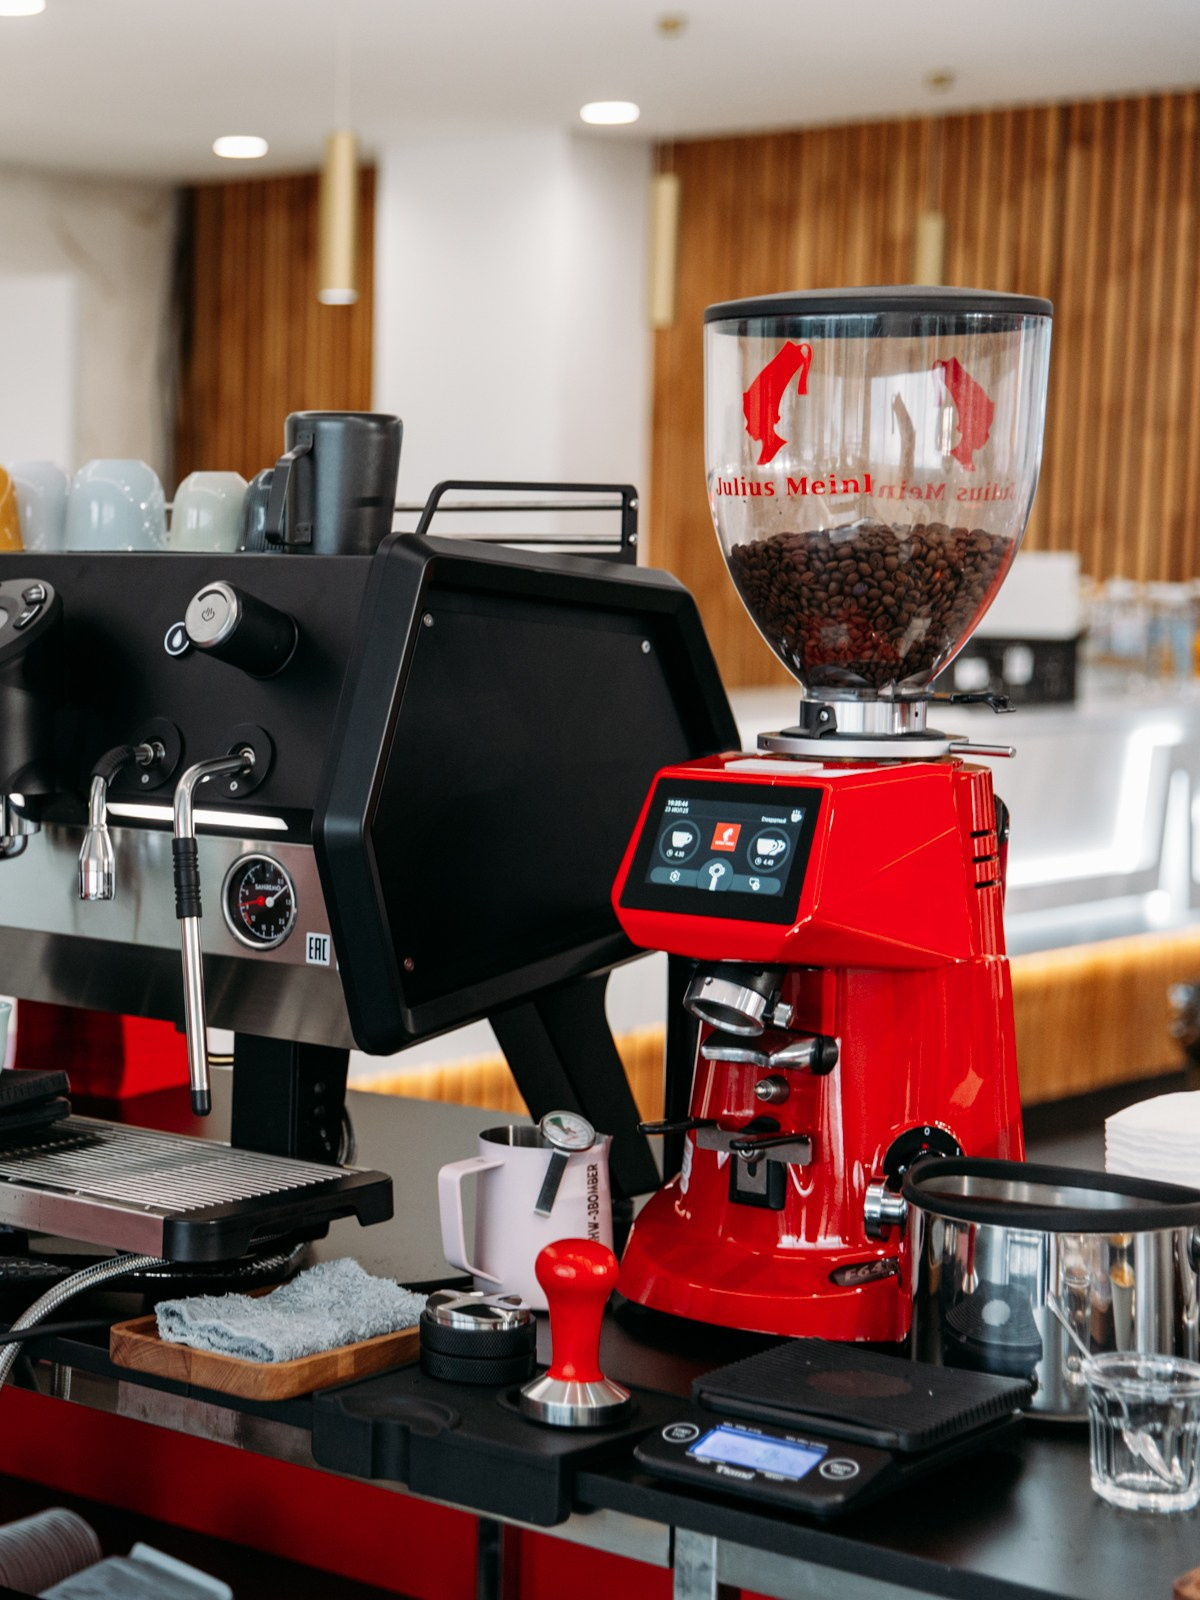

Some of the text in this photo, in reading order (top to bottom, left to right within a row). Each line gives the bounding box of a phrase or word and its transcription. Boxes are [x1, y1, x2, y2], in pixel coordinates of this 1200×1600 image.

[716, 474, 873, 496] Julius Meinl
[309, 936, 328, 962] EAC
[587, 1163, 600, 1242] HW-3BOMBER
